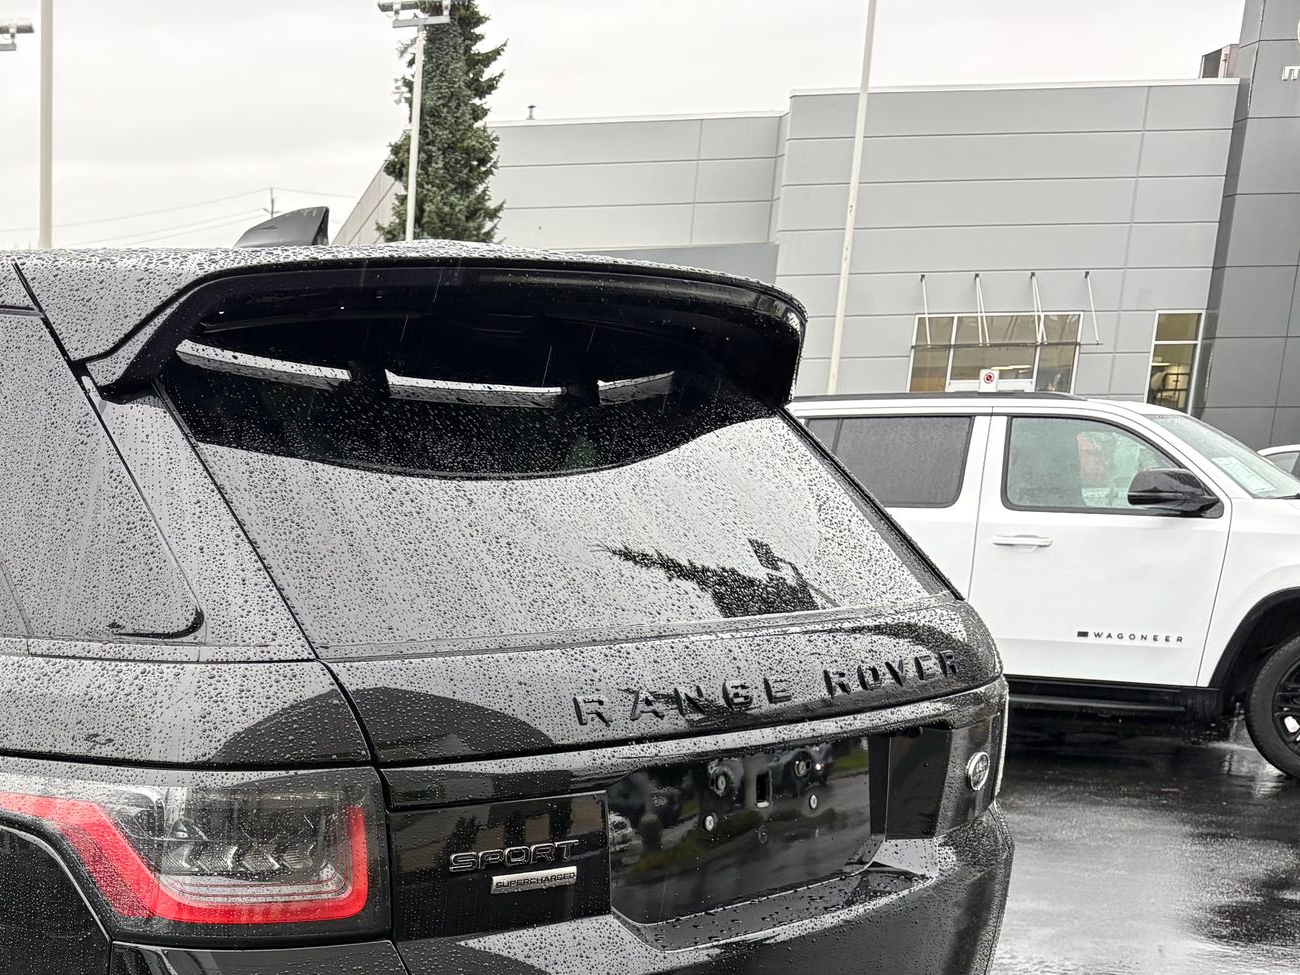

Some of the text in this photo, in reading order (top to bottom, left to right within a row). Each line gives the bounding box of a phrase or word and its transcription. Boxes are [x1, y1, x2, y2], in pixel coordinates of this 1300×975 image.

[1093, 631, 1183, 643] WAGONEER
[572, 650, 957, 728] RANGE ROVER
[449, 839, 579, 872] SPORT
[495, 872, 576, 889] SUPERCHARGED
